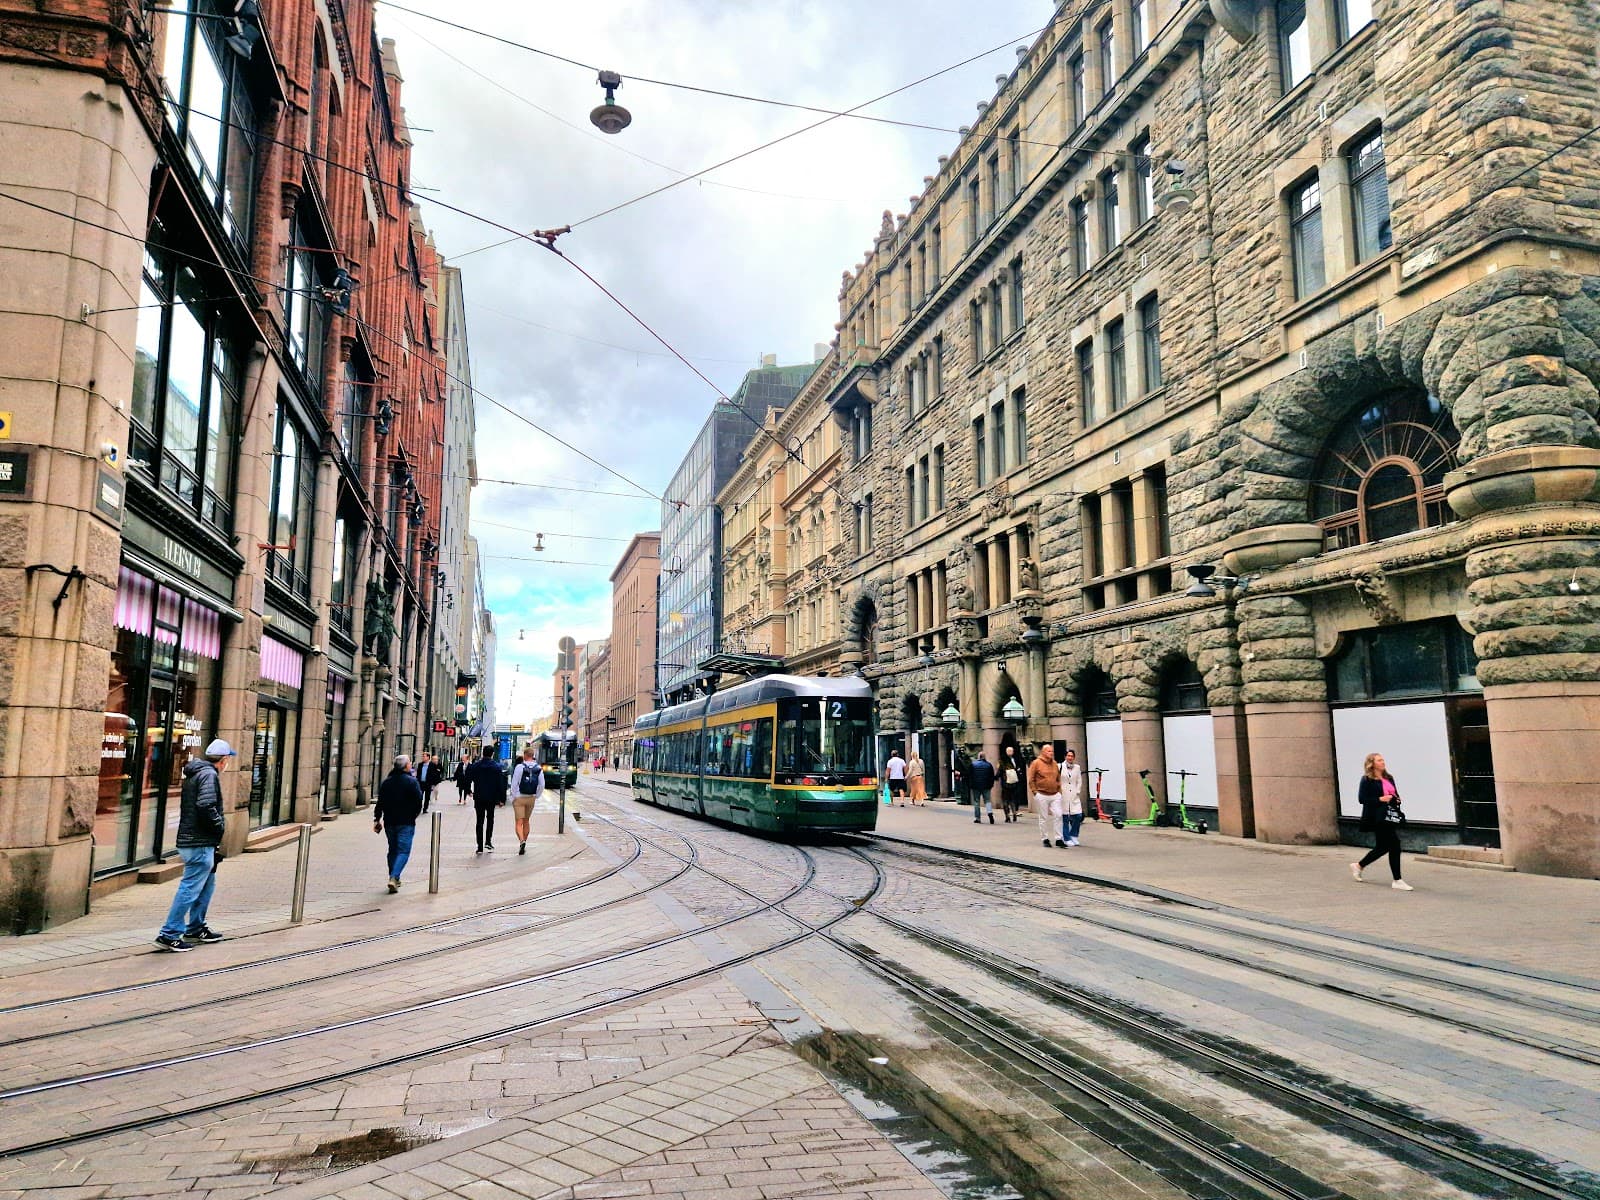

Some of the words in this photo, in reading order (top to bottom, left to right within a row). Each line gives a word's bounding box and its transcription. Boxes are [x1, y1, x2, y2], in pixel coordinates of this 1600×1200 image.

[832, 701, 842, 718] 2
[435, 721, 445, 731] D
[446, 727, 455, 736] D
[182, 732, 202, 750] garden
